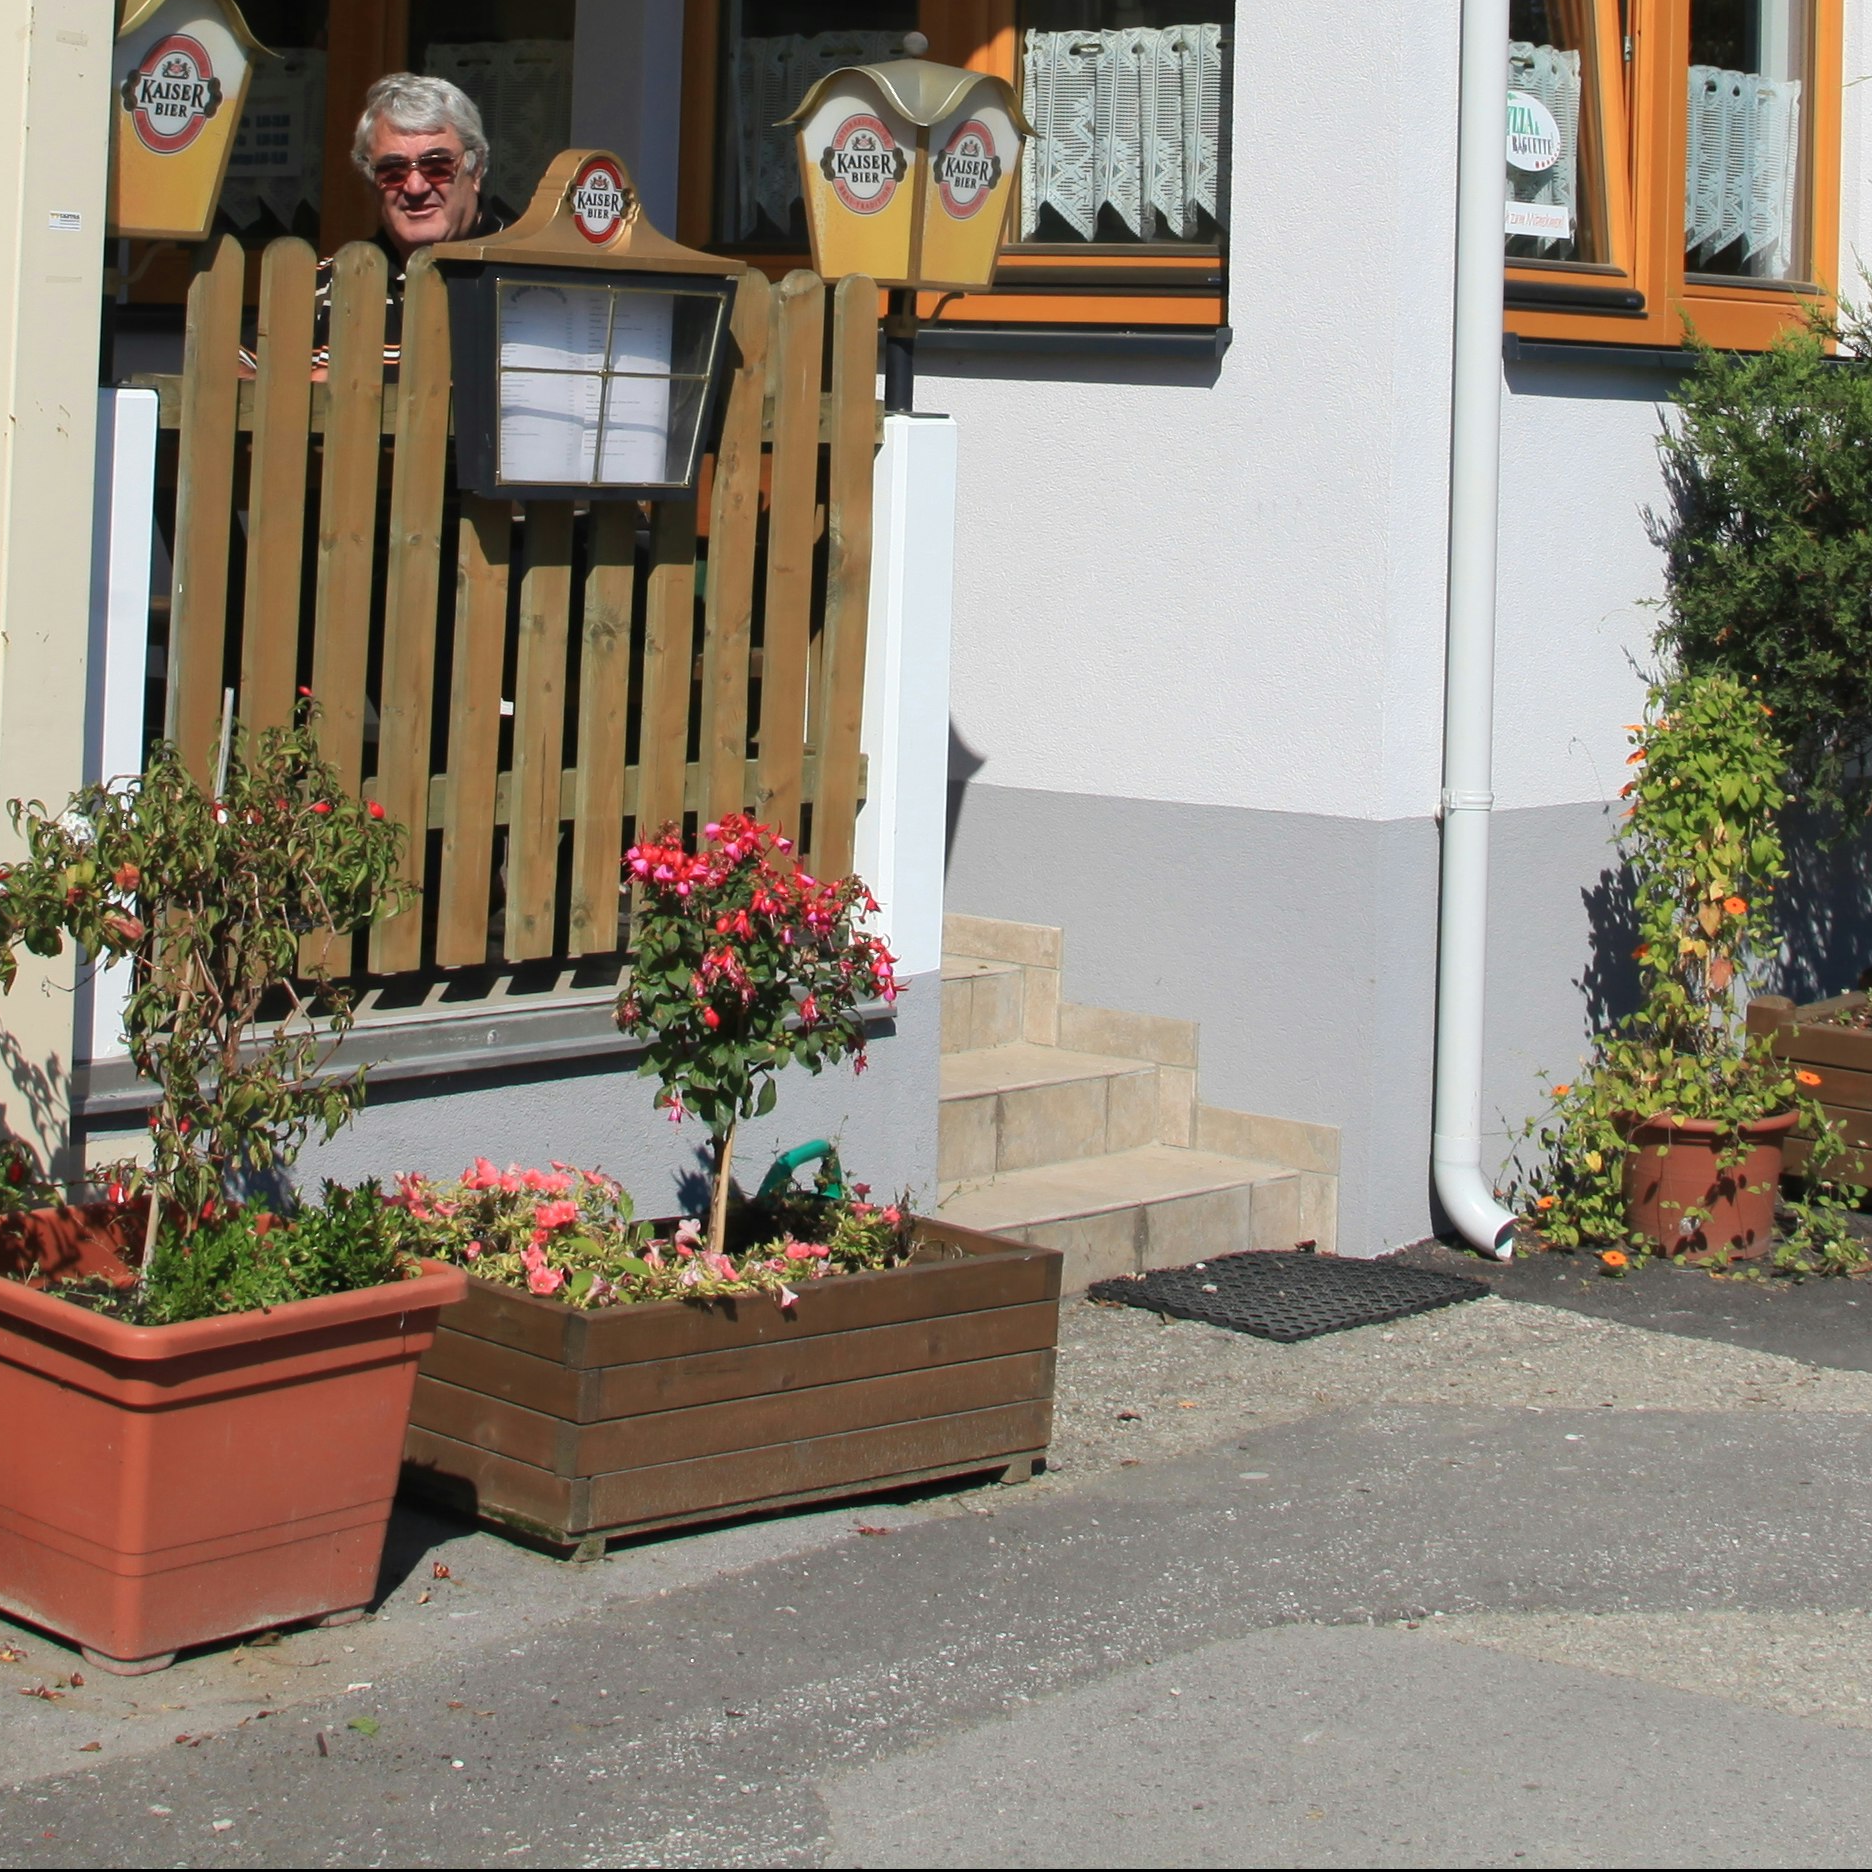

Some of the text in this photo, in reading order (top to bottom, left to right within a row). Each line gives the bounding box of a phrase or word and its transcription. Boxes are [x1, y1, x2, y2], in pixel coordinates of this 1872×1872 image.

[140, 79, 205, 108] KAISER
[155, 103, 188, 118] BIER
[1511, 134, 1553, 155] BAGUETTE
[837, 153, 893, 175] KAISER
[945, 156, 989, 181] KAISER
[851, 172, 880, 184] BIER
[954, 176, 977, 190] BIER
[577, 190, 620, 212] KAISER
[587, 207, 610, 220] BIER
